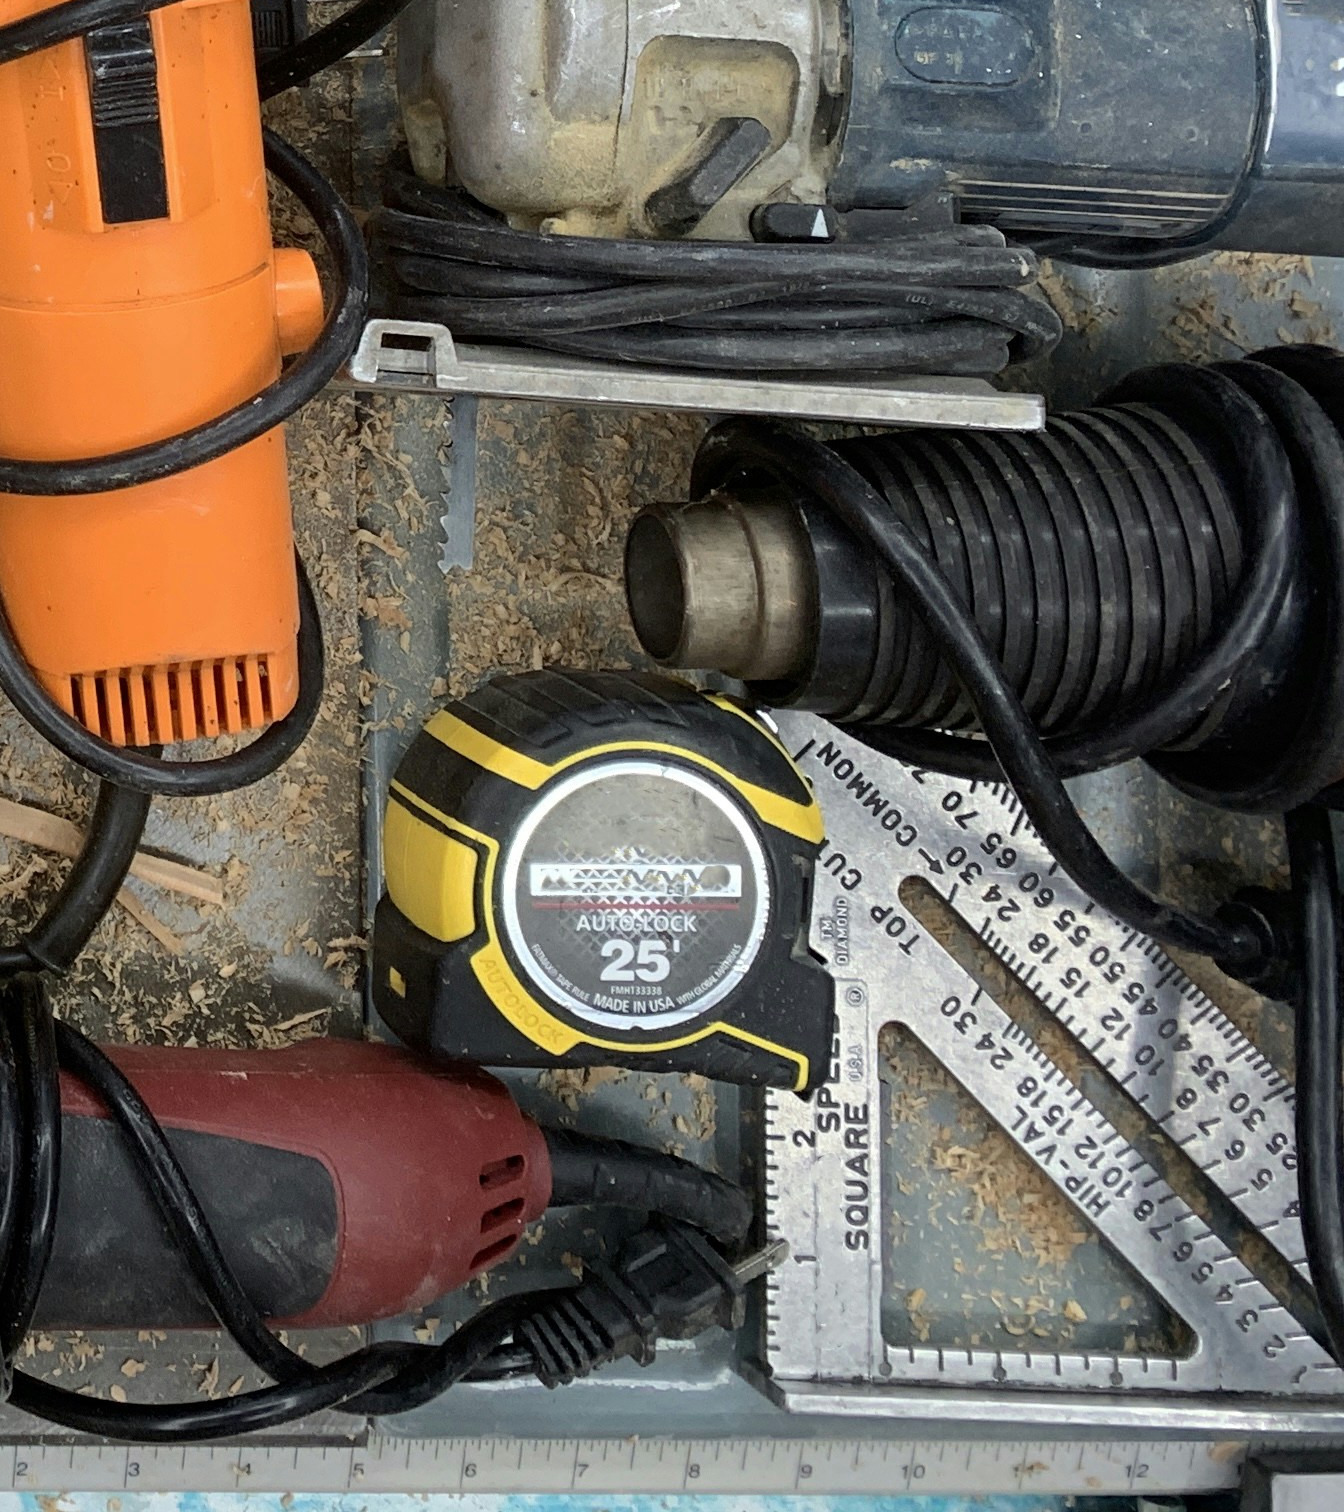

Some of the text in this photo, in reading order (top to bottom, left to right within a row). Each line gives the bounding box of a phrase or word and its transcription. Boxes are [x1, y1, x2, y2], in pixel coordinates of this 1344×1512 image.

[815, 741, 918, 847] COMMON
[942, 791, 979, 830] 70
[946, 846, 984, 886] 30
[980, 832, 1018, 869] 65
[981, 883, 1022, 923] 24
[1018, 872, 1055, 908] 60
[576, 914, 697, 933] AUTO-LOCK
[836, 896, 850, 966] DIAMOND
[870, 904, 921, 956] TOP
[1053, 909, 1091, 948] 55
[600, 939, 680, 982] 25'
[1028, 933, 1059, 965] 18
[1089, 946, 1126, 984] 50
[555, 973, 574, 993] TAPE
[571, 985, 590, 1002] RULE
[593, 993, 630, 1014] MADE
[633, 1000, 646, 1014] IN
[648, 996, 675, 1014] USA
[676, 991, 695, 1006] WITH
[693, 973, 718, 997] GLOBAL
[1059, 967, 1091, 999] 15
[1122, 982, 1159, 1017] 45
[940, 995, 978, 1035] 30
[1100, 1007, 1132, 1041] 12
[974, 1033, 1015, 1071] 24
[1158, 1018, 1193, 1052] 40
[1135, 1044, 1165, 1077] 10
[1191, 1054, 1230, 1094] 35
[1016, 1076, 1048, 1108] 18
[1176, 1088, 1198, 1111] 8
[1042, 1105, 1074, 1136] 15
[1198, 1117, 1222, 1137] 7
[1229, 1092, 1266, 1133] 30
[792, 1129, 815, 1148] 2
[1074, 1135, 1105, 1170] 12
[844, 1103, 870, 1251] SQUARE
[1012, 1105, 1111, 1218] HIP-VAL
[1102, 1166, 1133, 1199] 10
[1250, 1168, 1274, 1192] 5
[1133, 1199, 1155, 1222] 8
[1149, 1223, 1173, 1242] 7
[1191, 1262, 1214, 1285] 5
[16, 1462, 29, 1477] 2
[127, 1462, 141, 1477] 3
[464, 1463, 478, 1478] 6
[577, 1463, 589, 1478] 7
[688, 1463, 701, 1479] 8
[800, 1464, 813, 1479] 9
[901, 1464, 926, 1479] 10
[1125, 1464, 1149, 1479] 12
